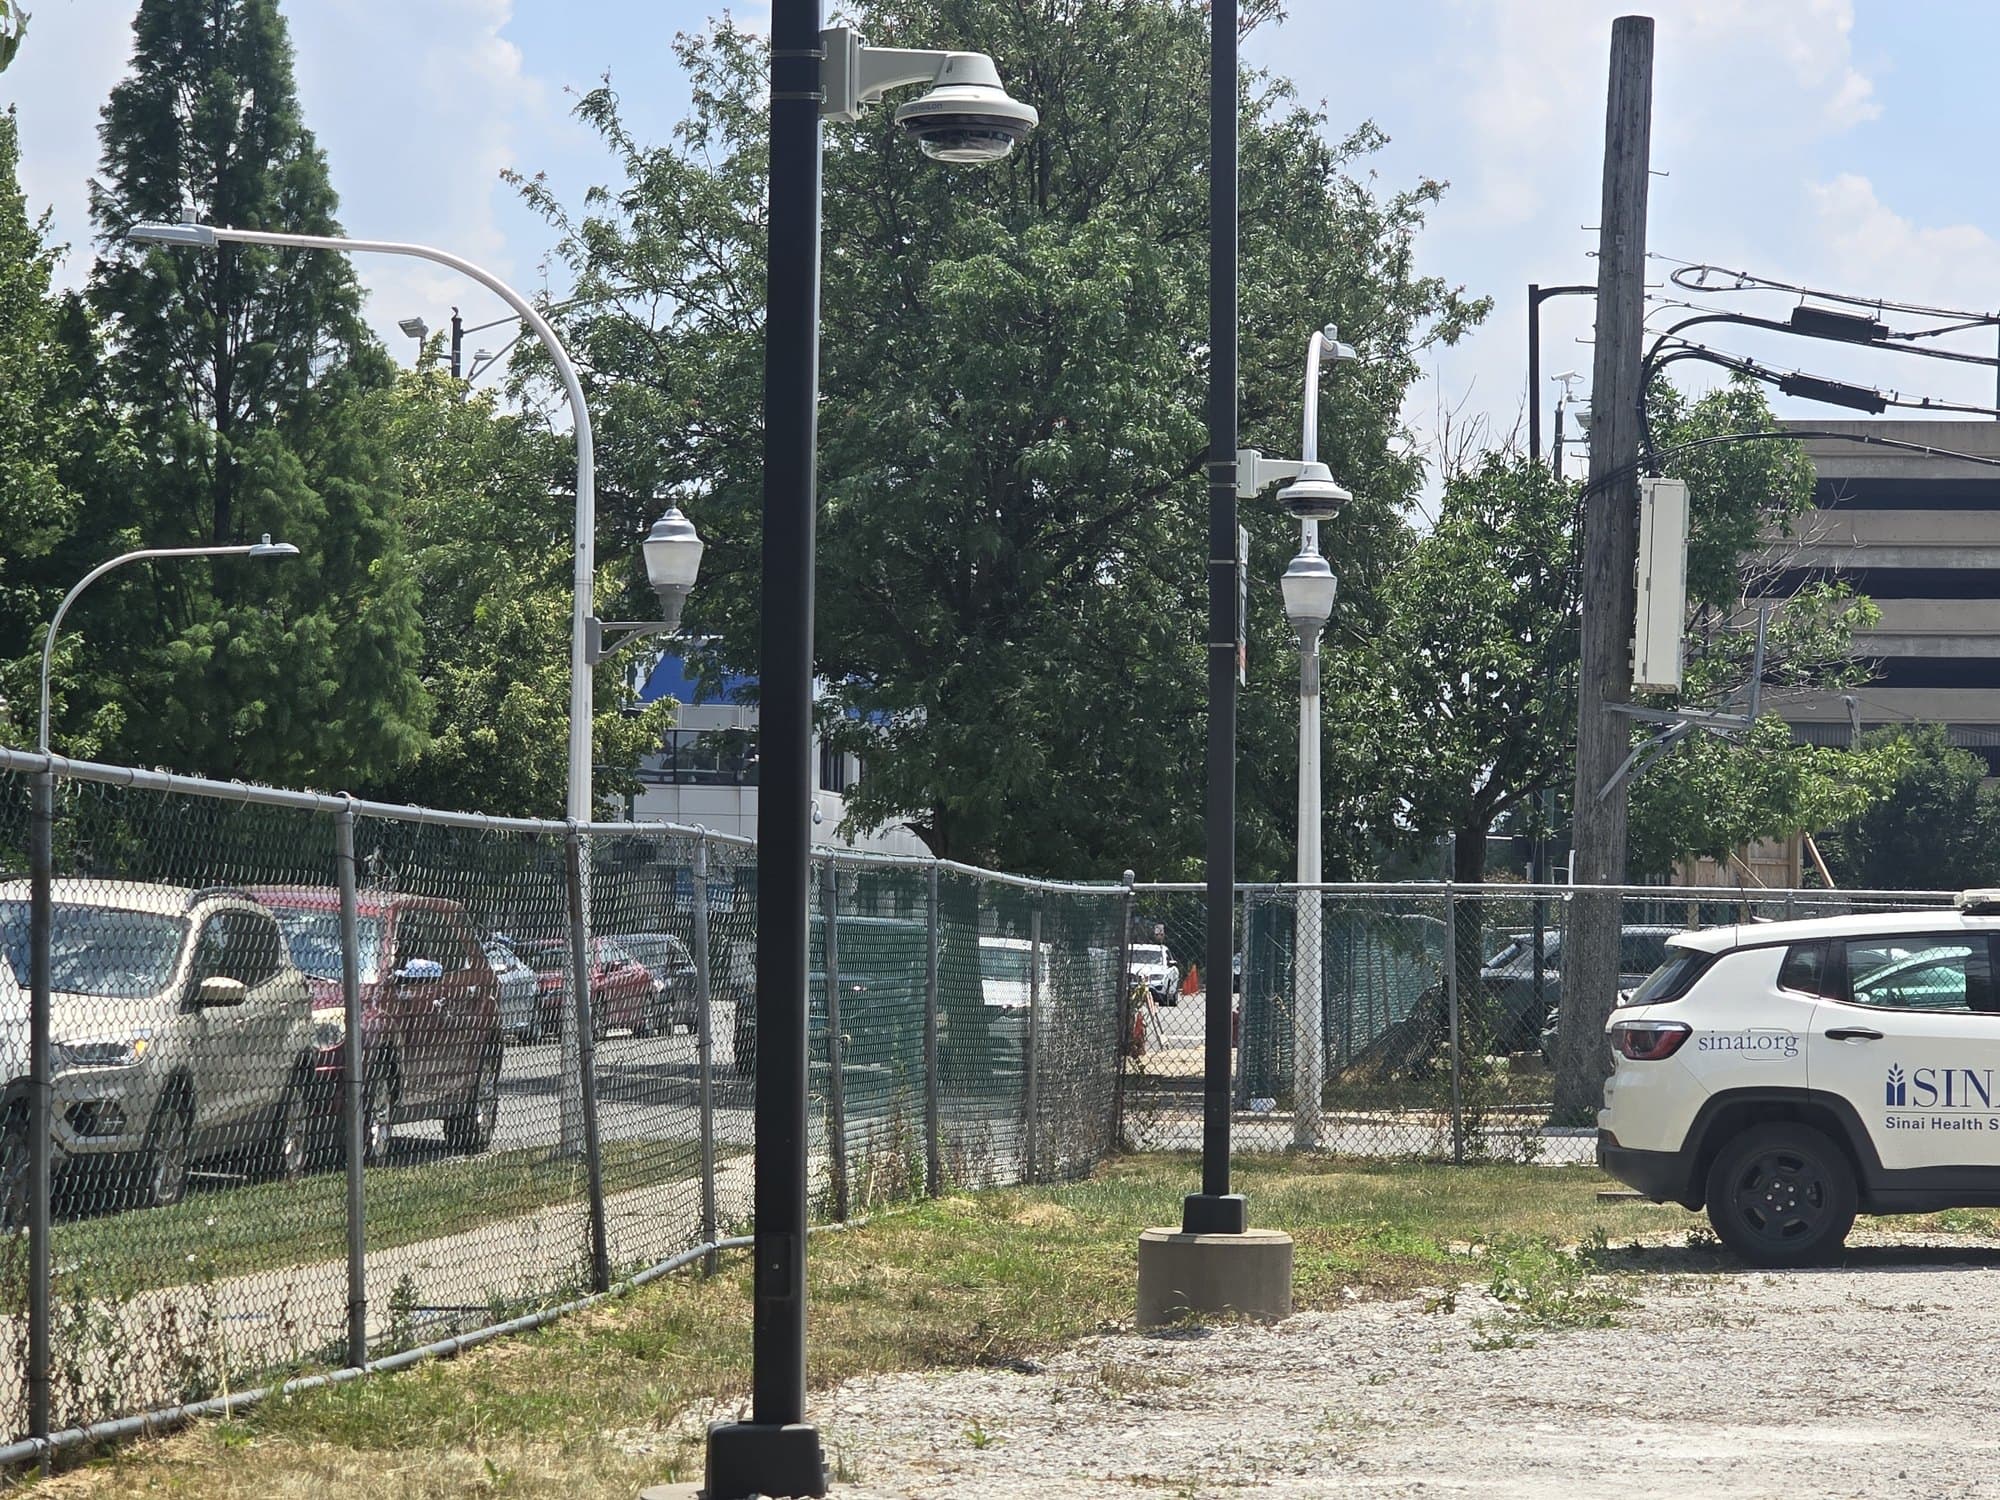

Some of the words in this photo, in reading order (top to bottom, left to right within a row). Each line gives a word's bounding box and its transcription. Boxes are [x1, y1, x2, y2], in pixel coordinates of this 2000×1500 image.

[1698, 1029, 1799, 1057] sinai.org
[1912, 1067, 2000, 1108] SIN
[1886, 1116, 1925, 1129] Sinai
[1931, 1117, 1983, 1130] Health
